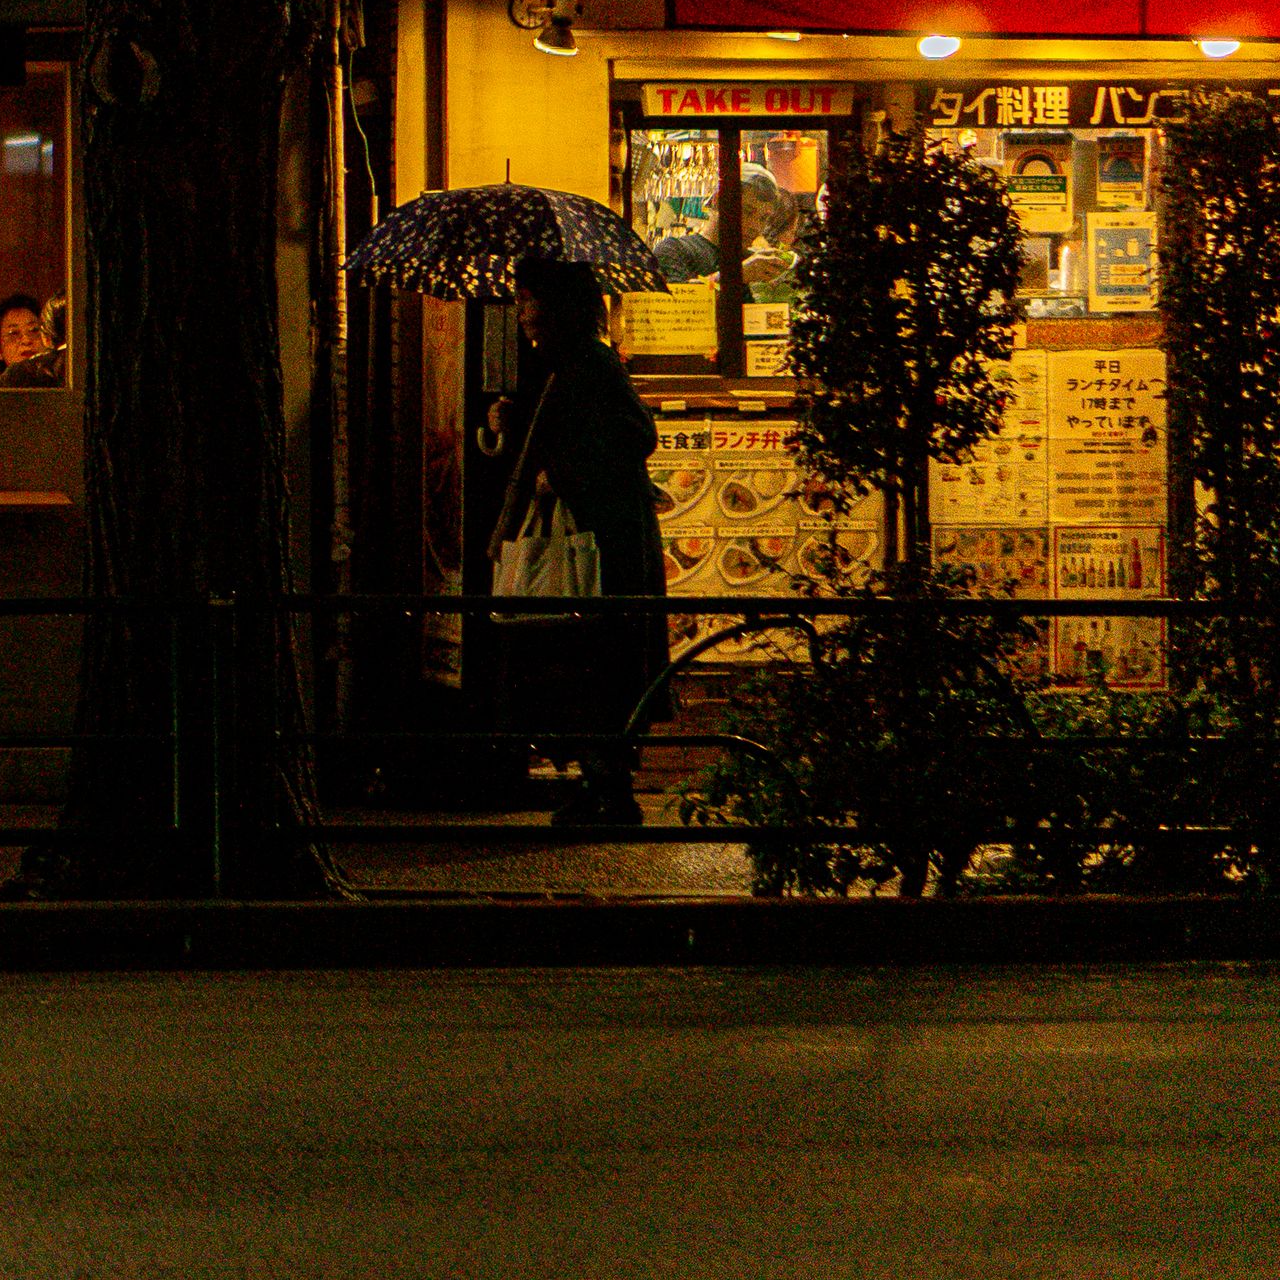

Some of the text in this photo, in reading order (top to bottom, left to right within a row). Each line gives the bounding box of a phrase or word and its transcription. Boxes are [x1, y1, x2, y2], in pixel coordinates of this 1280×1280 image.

[656, 86, 839, 114] TAKE OUT
[929, 85, 1070, 126] タイ料理
[1093, 359, 1122, 374] 平日
[1066, 378, 1150, 392] ランチタイム
[1081, 397, 1136, 410] 17時まで
